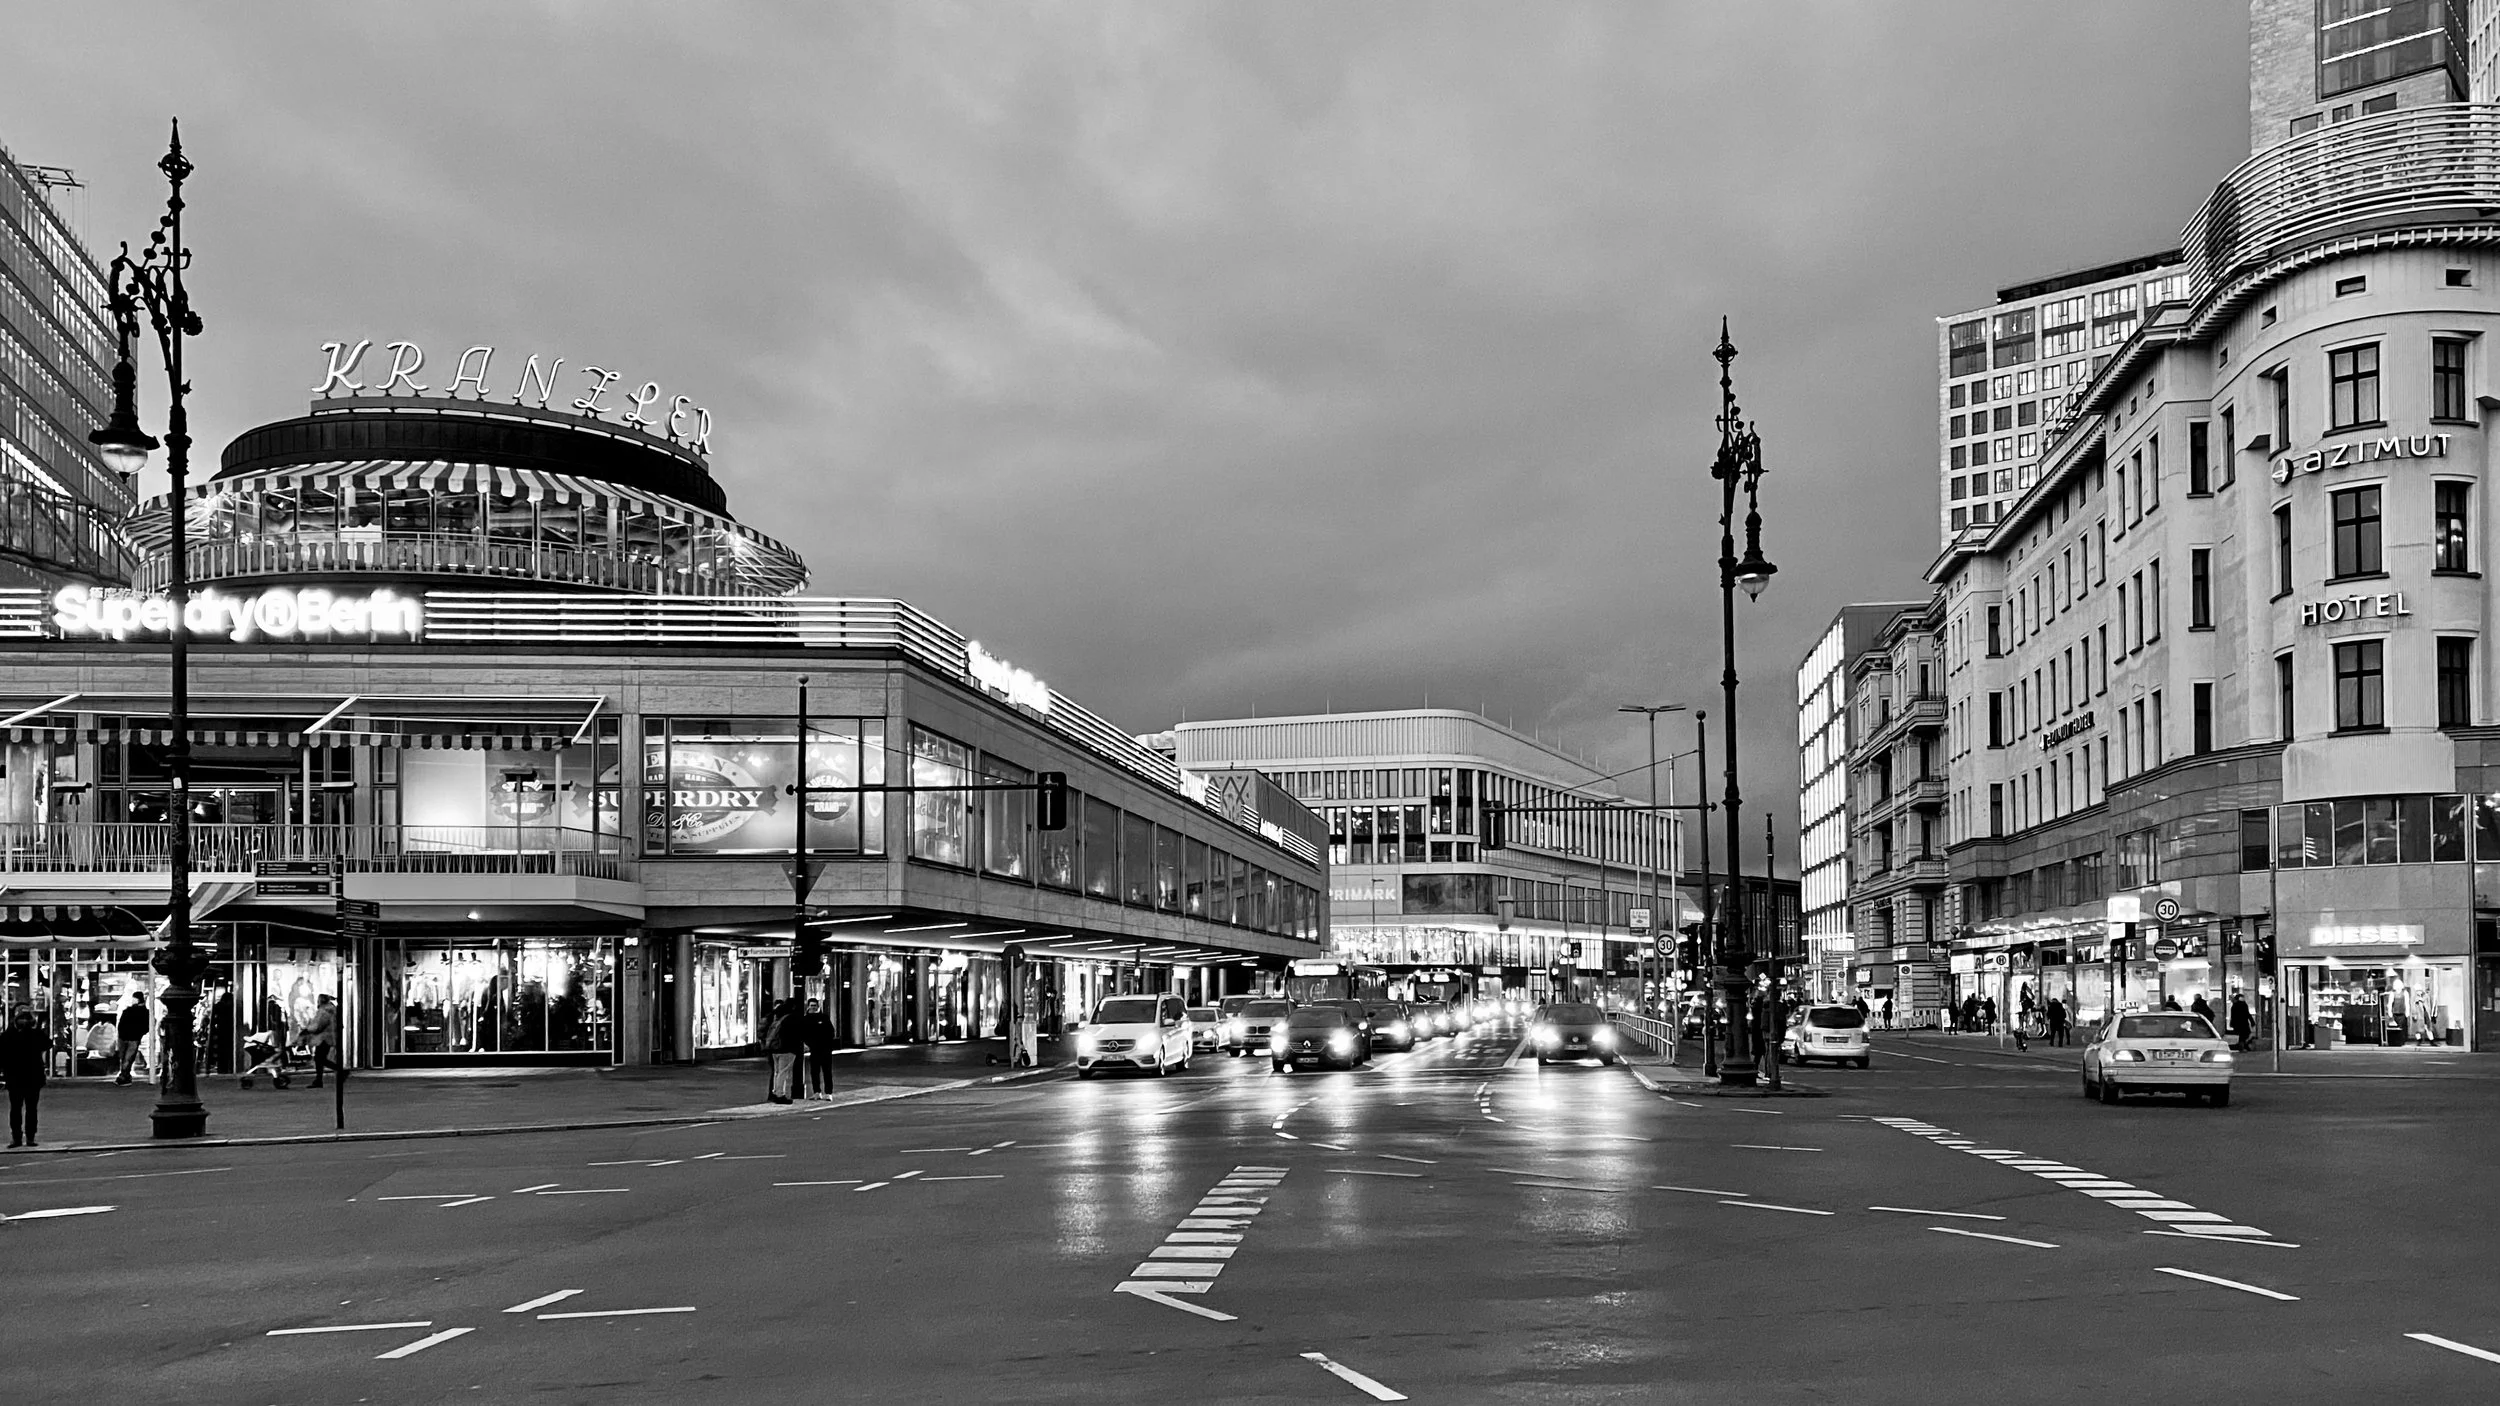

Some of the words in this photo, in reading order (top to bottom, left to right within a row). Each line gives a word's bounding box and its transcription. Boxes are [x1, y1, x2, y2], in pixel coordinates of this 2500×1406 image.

[311, 339, 713, 456] KRANZLER
[2301, 592, 2410, 625] HOTEL
[588, 790, 763, 808] SERDRY
[2160, 904, 2175, 915] 30
[2314, 925, 2417, 945] DIESEL
[1659, 939, 1672, 951] 30
